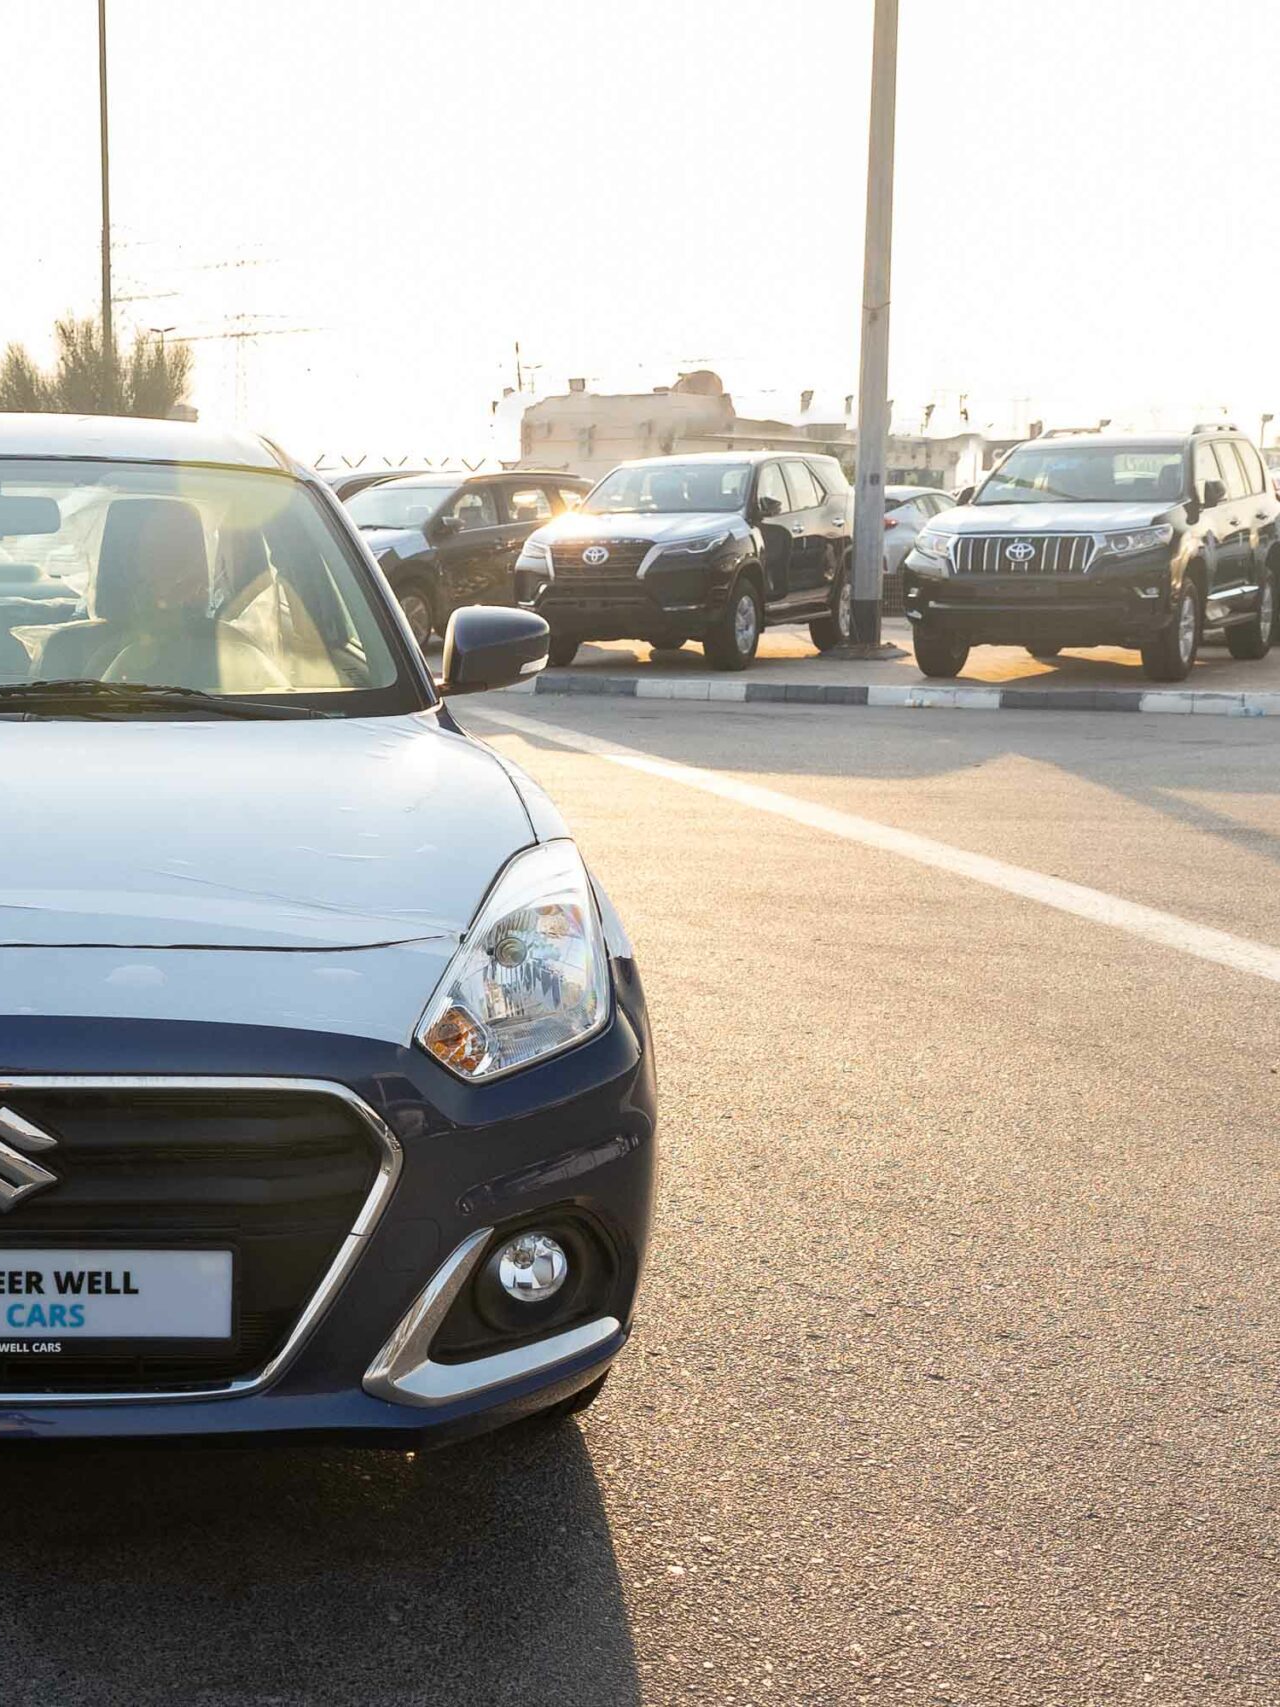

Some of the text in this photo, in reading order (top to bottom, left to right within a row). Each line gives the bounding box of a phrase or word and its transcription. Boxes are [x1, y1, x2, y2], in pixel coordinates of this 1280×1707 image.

[53, 1270, 139, 1295] WELL
[6, 1303, 86, 1329] CARS
[32, 1342, 62, 1353] CARS
